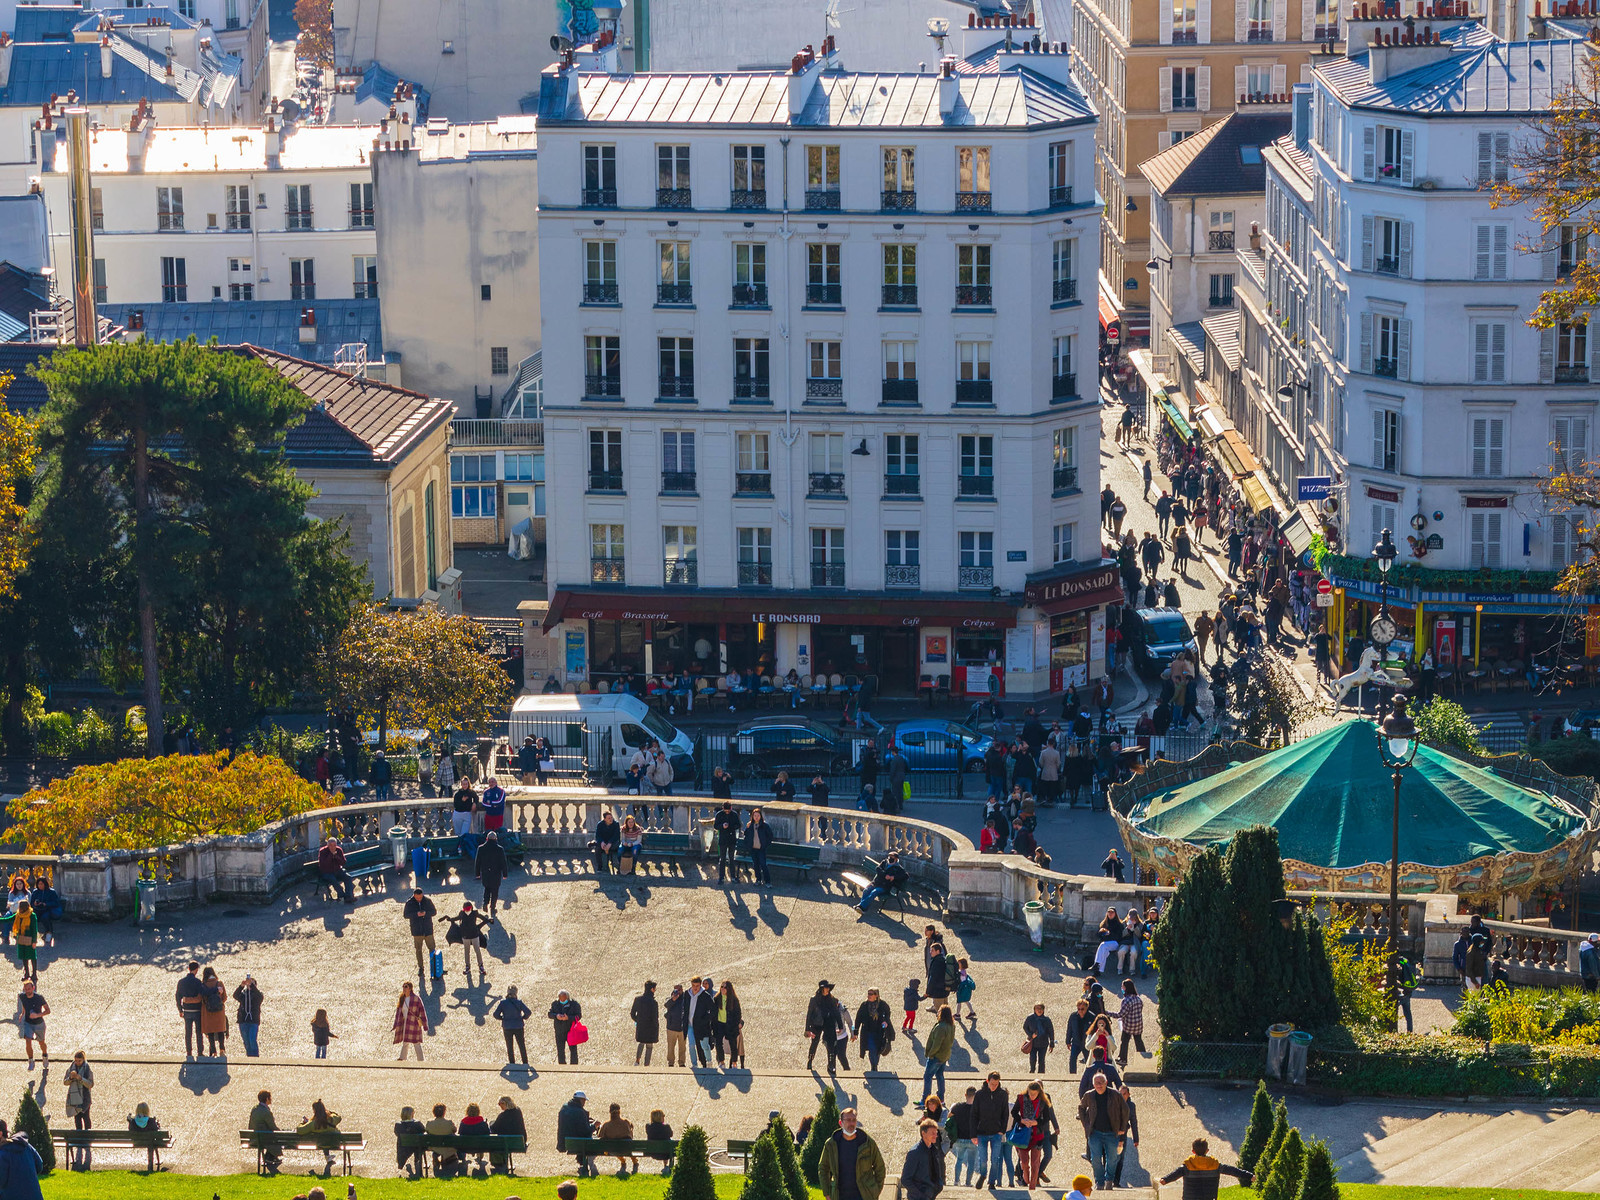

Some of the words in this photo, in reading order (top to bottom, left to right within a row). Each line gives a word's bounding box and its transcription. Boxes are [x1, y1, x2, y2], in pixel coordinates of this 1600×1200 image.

[1045, 586, 1056, 600] LE
[1061, 572, 1113, 596] RONSARD
[582, 611, 603, 620] Café
[621, 611, 669, 620] Brasserie
[752, 613, 766, 622] LE
[769, 613, 821, 623] RONSARD
[902, 617, 920, 627] Café
[963, 618, 996, 628] Crêpes
